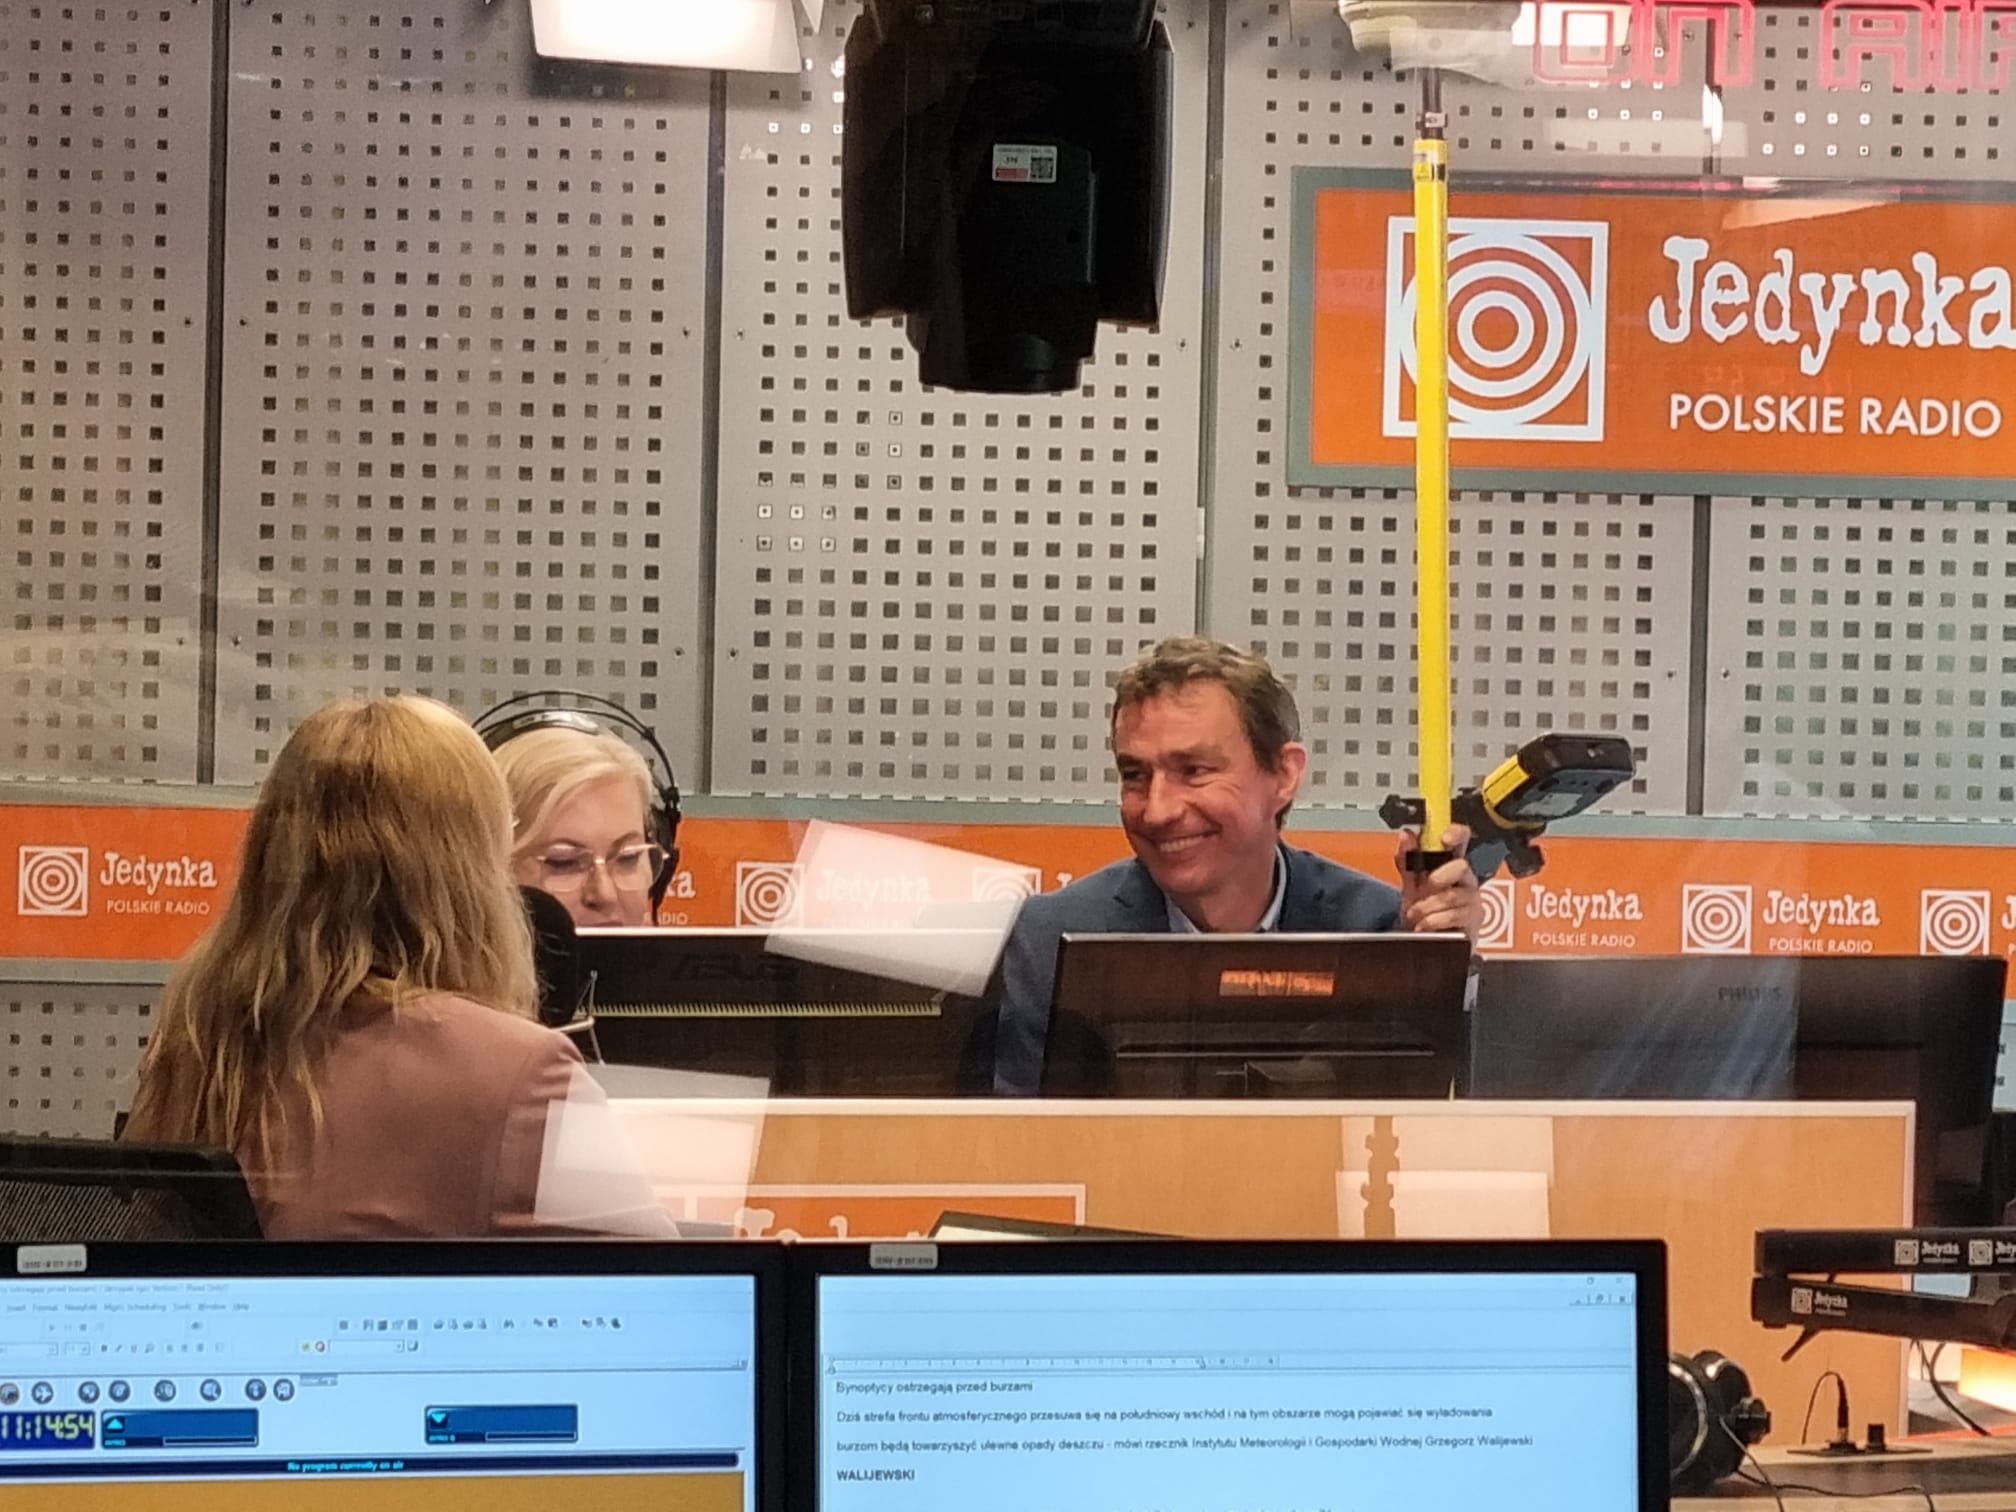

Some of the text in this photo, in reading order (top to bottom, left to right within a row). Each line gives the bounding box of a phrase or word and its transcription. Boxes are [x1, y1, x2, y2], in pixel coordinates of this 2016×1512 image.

[1649, 234, 2016, 376] Jedynka
[1670, 393, 2002, 438] POLSKIE RADIO
[100, 852, 218, 896] Jedynka
[106, 900, 211, 915] POLSKIE RADIO
[1526, 884, 1643, 929] Jedynka
[1763, 890, 1881, 934] Jedynka
[1532, 932, 1636, 948] POLSKIE RADIO
[1769, 937, 1873, 954] POLSKIE RADIO
[956, 1381, 987, 1392] przed
[990, 1381, 1034, 1391] burzami
[864, 1411, 895, 1421] strefa
[898, 1410, 930, 1421] frontu
[932, 1411, 1027, 1423] atmosferycznego
[1030, 1411, 1082, 1422] przesuwa
[1104, 1411, 1117, 1420] na
[1183, 1408, 1225, 1420] wschód
[1234, 1410, 1247, 1419] na
[1249, 1409, 1269, 1420] tym
[1272, 1408, 1320, 1419] obszarze
[836, 1440, 877, 1451] burzom
[980, 1440, 1018, 1450] ulewne
[1022, 1438, 1055, 1452] opady
[1058, 1438, 1104, 1450] deszczu
[1114, 1437, 1142, 1449] mówi
[1145, 1437, 1188, 1449] rzecznik
[1192, 1437, 1236, 1450] Instytutu
[1315, 1436, 1377, 1449] Gospodarki
[1380, 1435, 1423, 1449] Wodnej
[1425, 1435, 1475, 1449] Grzegorz
[836, 1469, 915, 1481] WALIJEWSKI
